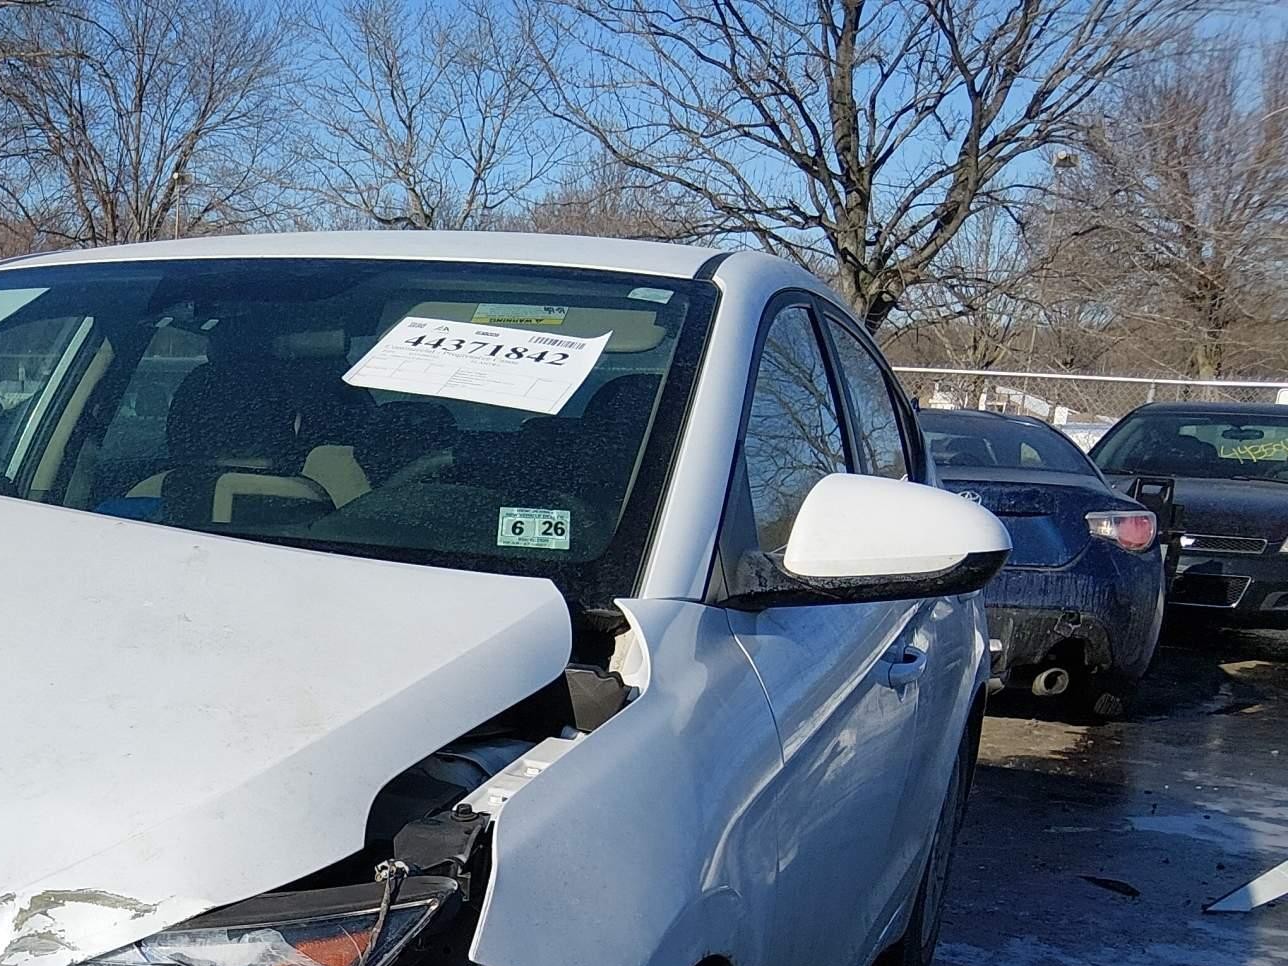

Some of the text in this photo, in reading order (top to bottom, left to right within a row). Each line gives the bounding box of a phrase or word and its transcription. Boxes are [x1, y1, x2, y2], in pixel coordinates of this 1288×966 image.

[404, 335, 570, 366] 44371842
[511, 520, 565, 537] 6 26
